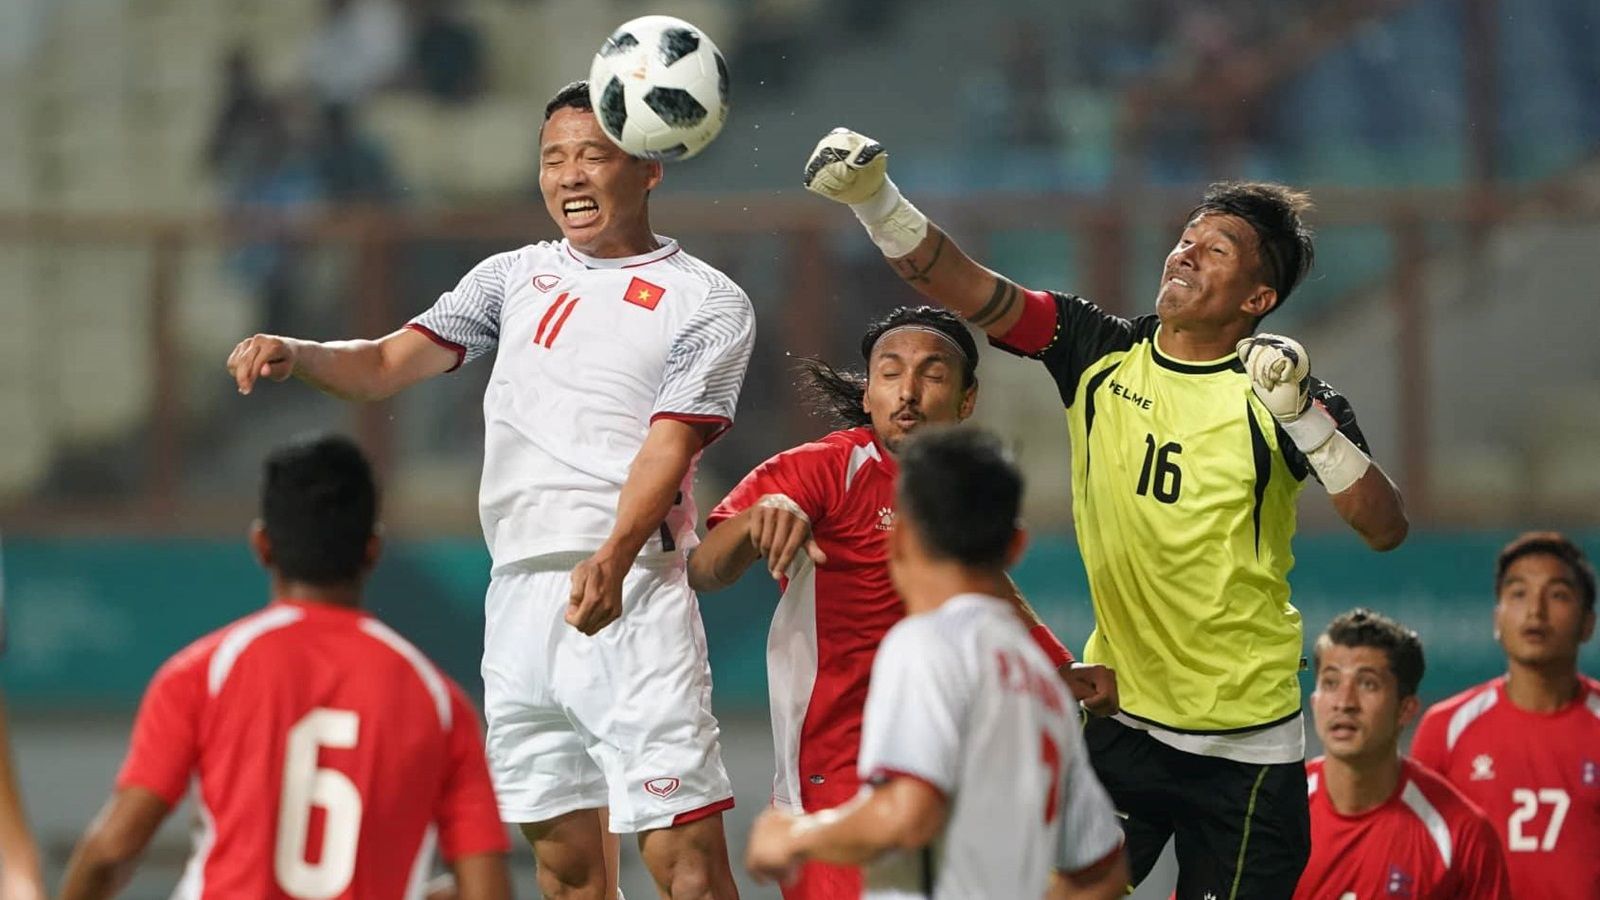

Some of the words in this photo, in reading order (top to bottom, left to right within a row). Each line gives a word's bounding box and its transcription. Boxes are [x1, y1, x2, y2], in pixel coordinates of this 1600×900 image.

[533, 291, 581, 349] 11
[1136, 433, 1183, 504] 16
[274, 707, 363, 900] 6
[1508, 788, 1571, 852] 27
